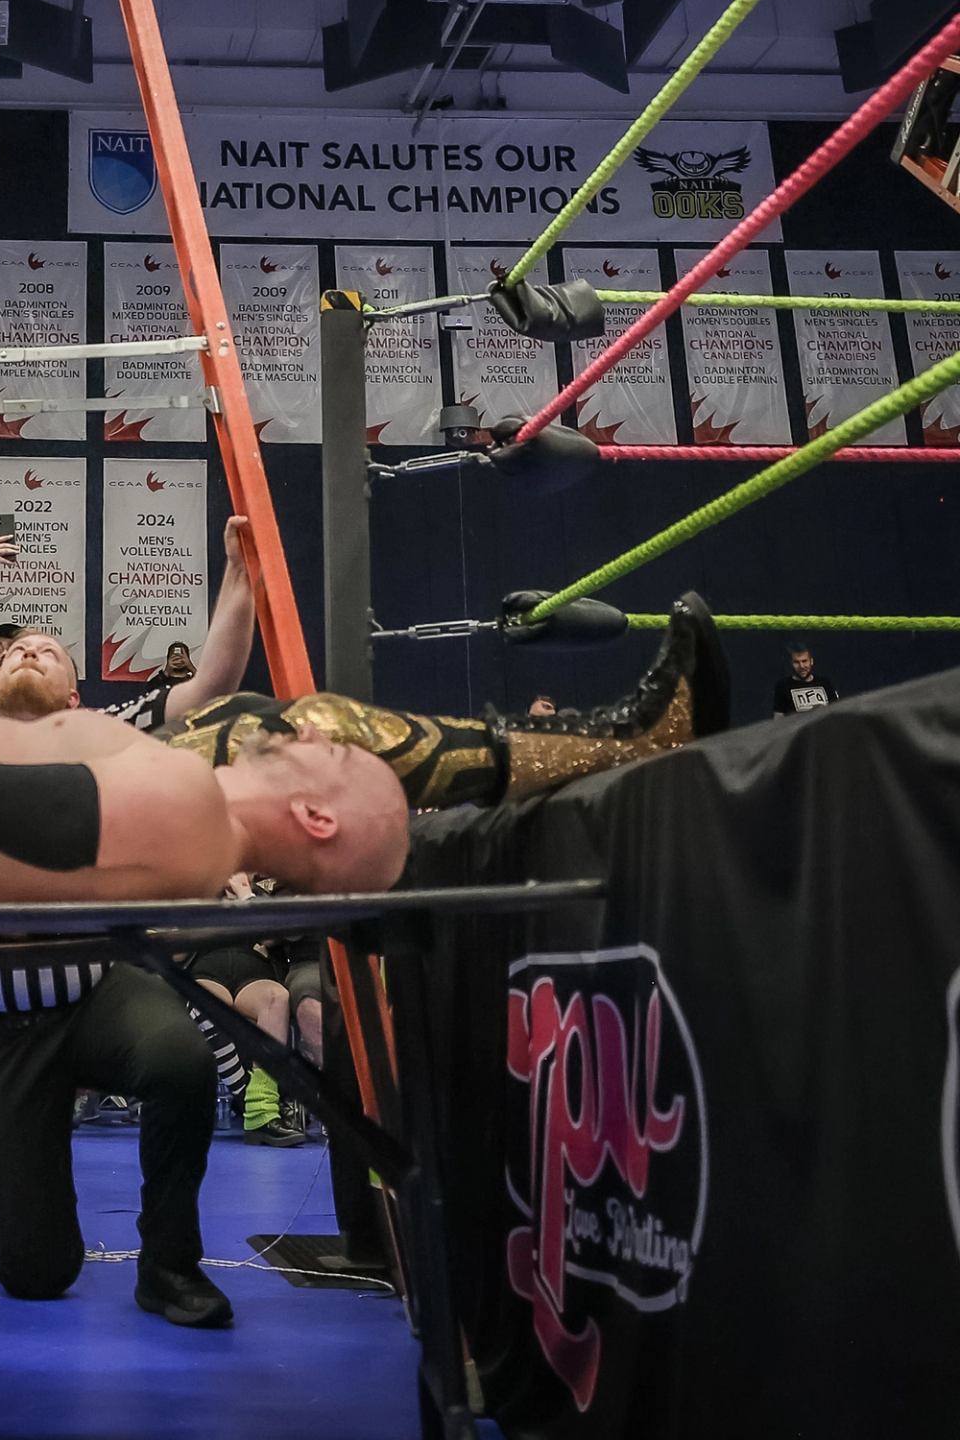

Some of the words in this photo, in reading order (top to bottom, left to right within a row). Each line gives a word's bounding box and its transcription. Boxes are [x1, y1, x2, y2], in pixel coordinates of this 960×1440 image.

[96, 135, 149, 153] NAIT
[221, 140, 309, 168] NAIT
[322, 142, 483, 171] SALUTES
[495, 145, 577, 172] OUR
[678, 179, 714, 190] NAIT
[653, 191, 745, 219] OOKS
[19, 283, 54, 294] 2008
[136, 285, 170, 295] 2009
[252, 287, 287, 297] 2009
[373, 288, 398, 299] 2011
[5, 300, 67, 309] BADMINTON
[123, 302, 184, 310] BADMINTON
[239, 304, 301, 312] BADMINTON
[233, 313, 264, 321] MEN'S
[266, 313, 308, 322] SINGLES
[10, 323, 62, 332] NATIONAL
[128, 324, 180, 333] NATIONAL
[244, 326, 296, 336] NATIONAL
[705, 330, 756, 338] NATIONAL
[818, 330, 868, 339] NATIONAL
[233, 335, 310, 347] CHAMPION
[467, 338, 544, 349] CHAMPION
[690, 338, 774, 350] CHAMPIONS
[807, 339, 882, 352] CHAMPION
[240, 348, 302, 358] CANADIENS
[476, 351, 536, 359] CANADIENS
[703, 351, 763, 360] CANADIENS
[817, 352, 876, 361] CANADIENS
[123, 362, 185, 370] BADMINTON
[241, 362, 304, 372] BADMINTON
[486, 366, 527, 374] SOCCER
[704, 366, 765, 374] BADMINTON
[818, 367, 878, 375] BADMINTON
[265, 373, 316, 382] MASCULIN
[481, 375, 534, 384] MASCULIN
[15, 500, 52, 512] 2022
[137, 514, 174, 527] 2024
[16, 533, 51, 542] MEN'S
[139, 536, 174, 545] MEN'S
[120, 547, 192, 556] VOLLEYBALL
[128, 562, 184, 572] NATIONAL
[108, 572, 203, 585] CHAMPIONS
[122, 588, 190, 599] CANADIENS
[120, 604, 192, 616] VOLLEYBALL
[12, 615, 52, 624] SIMPLE
[126, 617, 186, 626] MASCULIN
